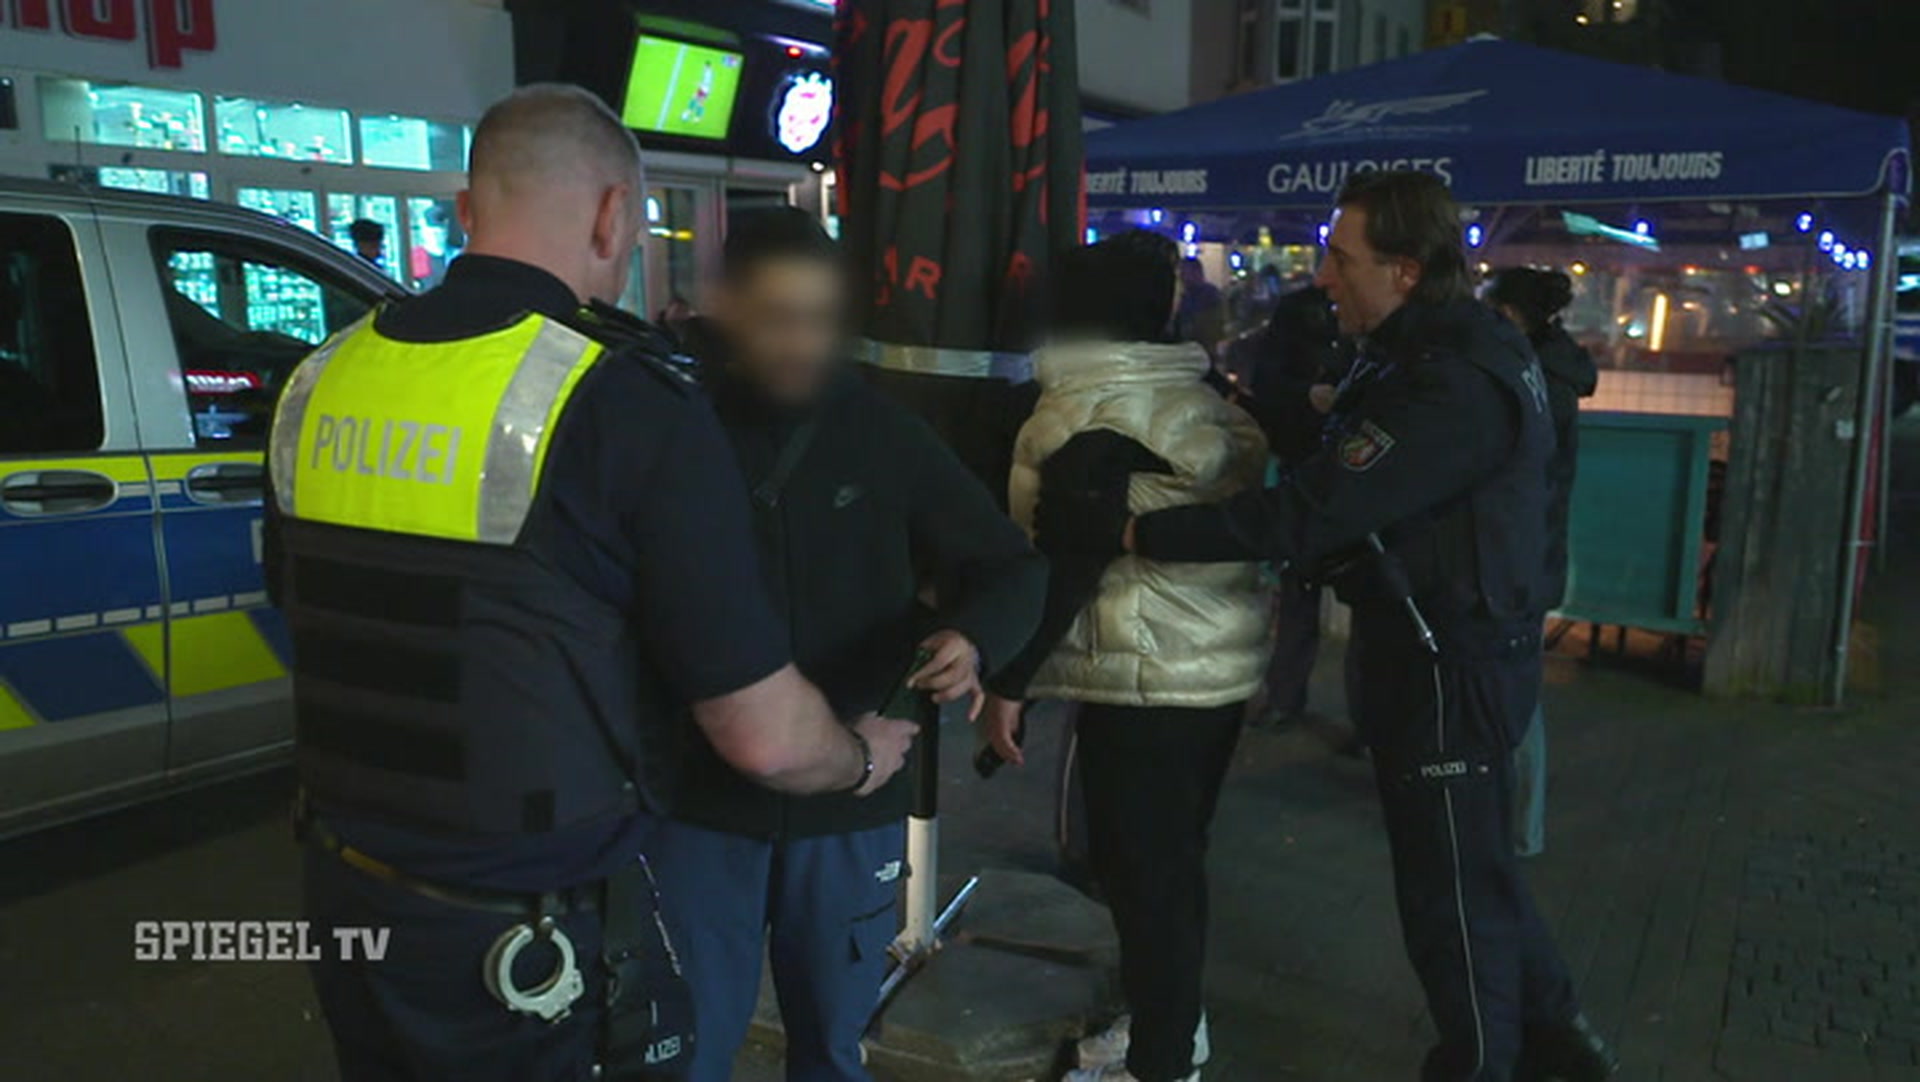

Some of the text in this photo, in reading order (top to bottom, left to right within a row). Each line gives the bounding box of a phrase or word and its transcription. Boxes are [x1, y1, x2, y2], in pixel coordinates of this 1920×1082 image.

[1525, 149, 1724, 185] LIBERTÉ TOUJOURS
[311, 413, 463, 486] POLIZEI
[1420, 760, 1468, 778] POLIZEI
